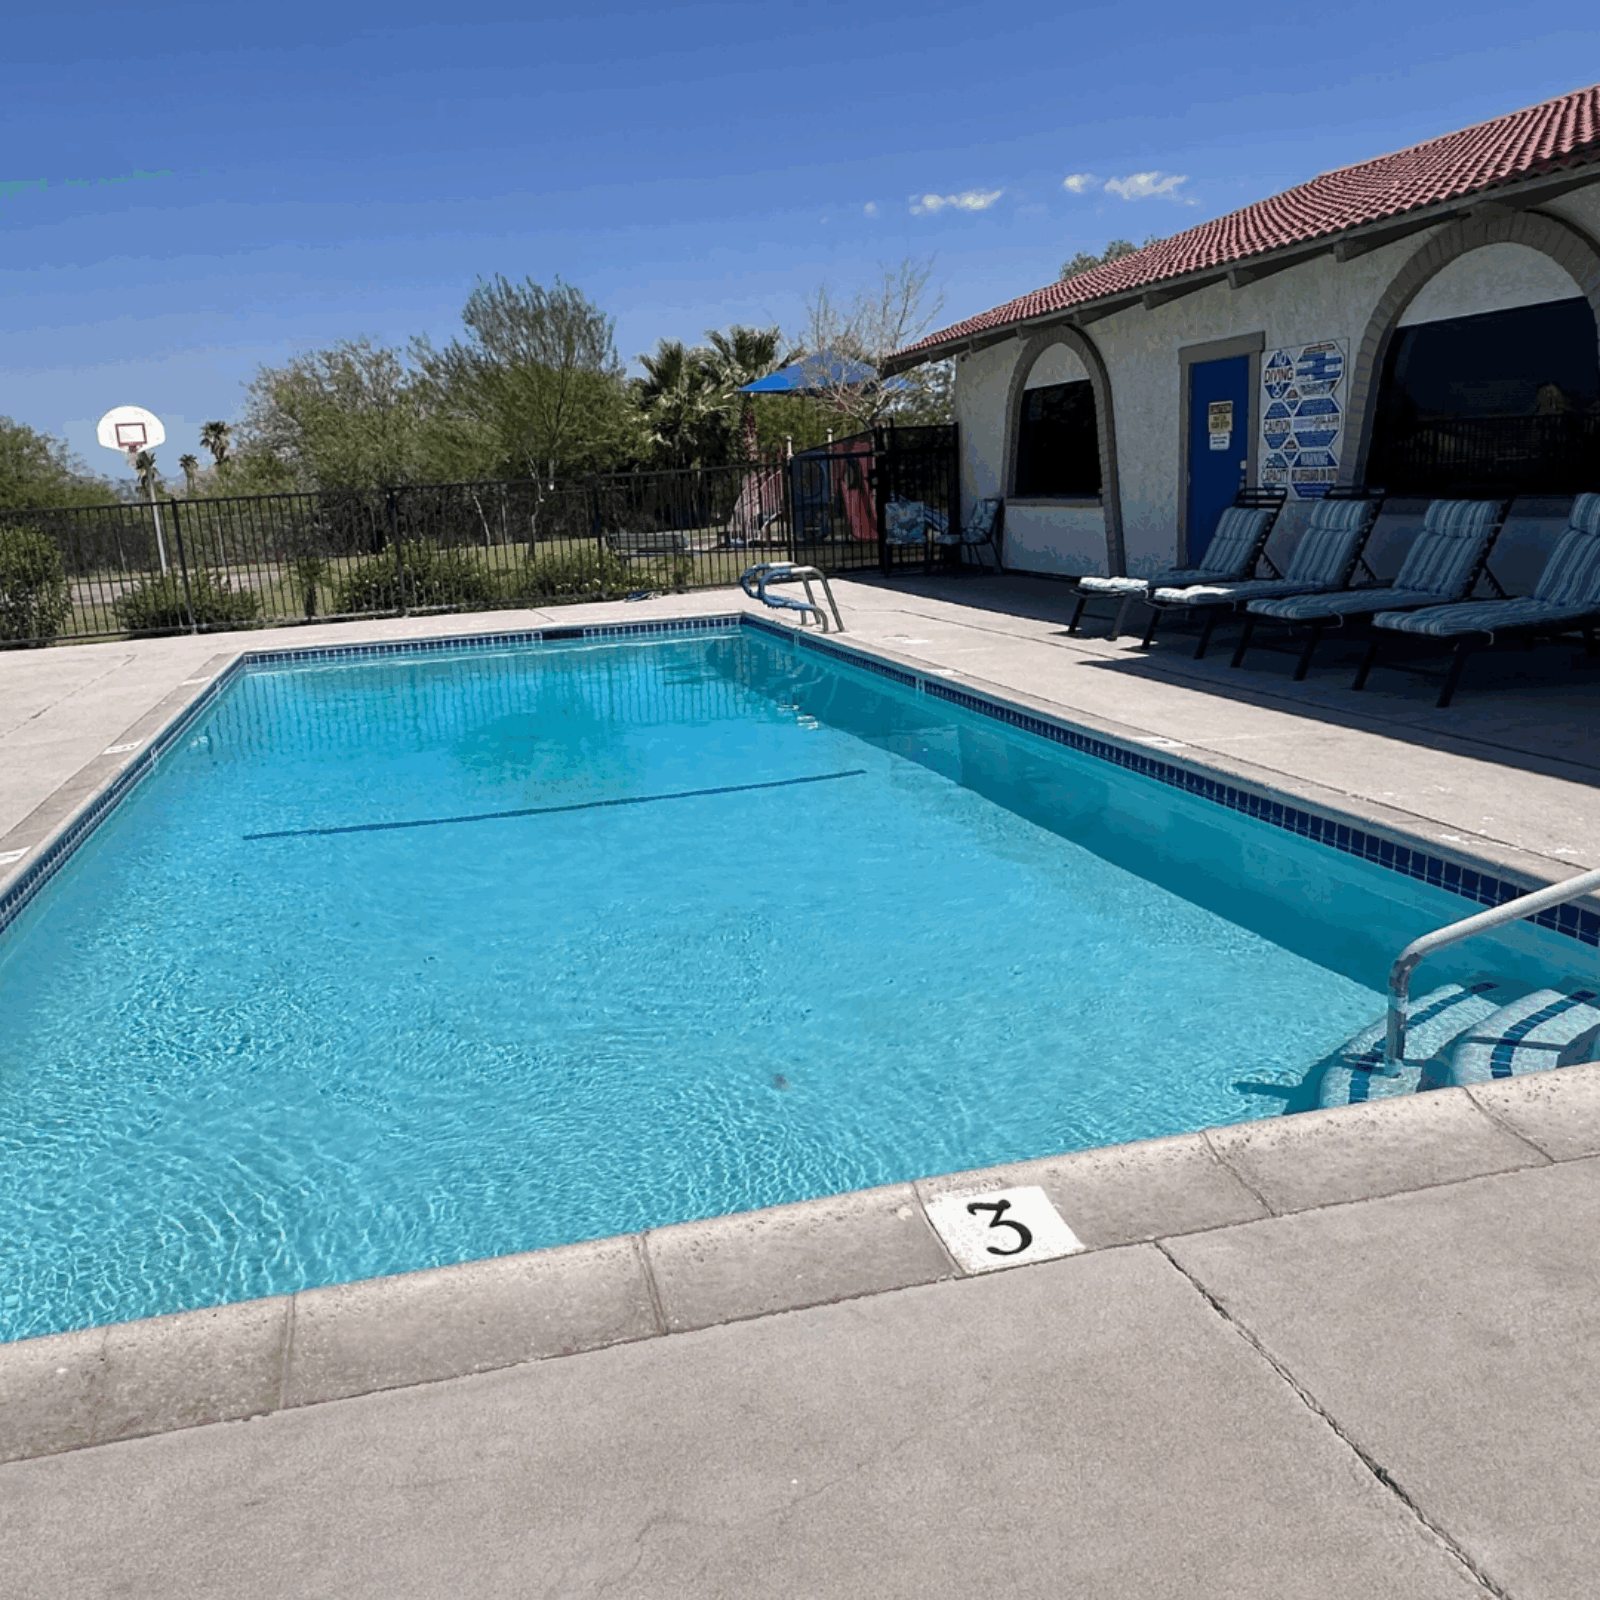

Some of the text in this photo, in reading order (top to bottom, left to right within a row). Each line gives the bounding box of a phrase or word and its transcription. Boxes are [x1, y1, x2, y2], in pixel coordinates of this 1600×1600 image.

[1264, 367, 1293, 383] DIVING
[1264, 420, 1291, 434] CAUTION
[966, 1199, 1033, 1256] 3
